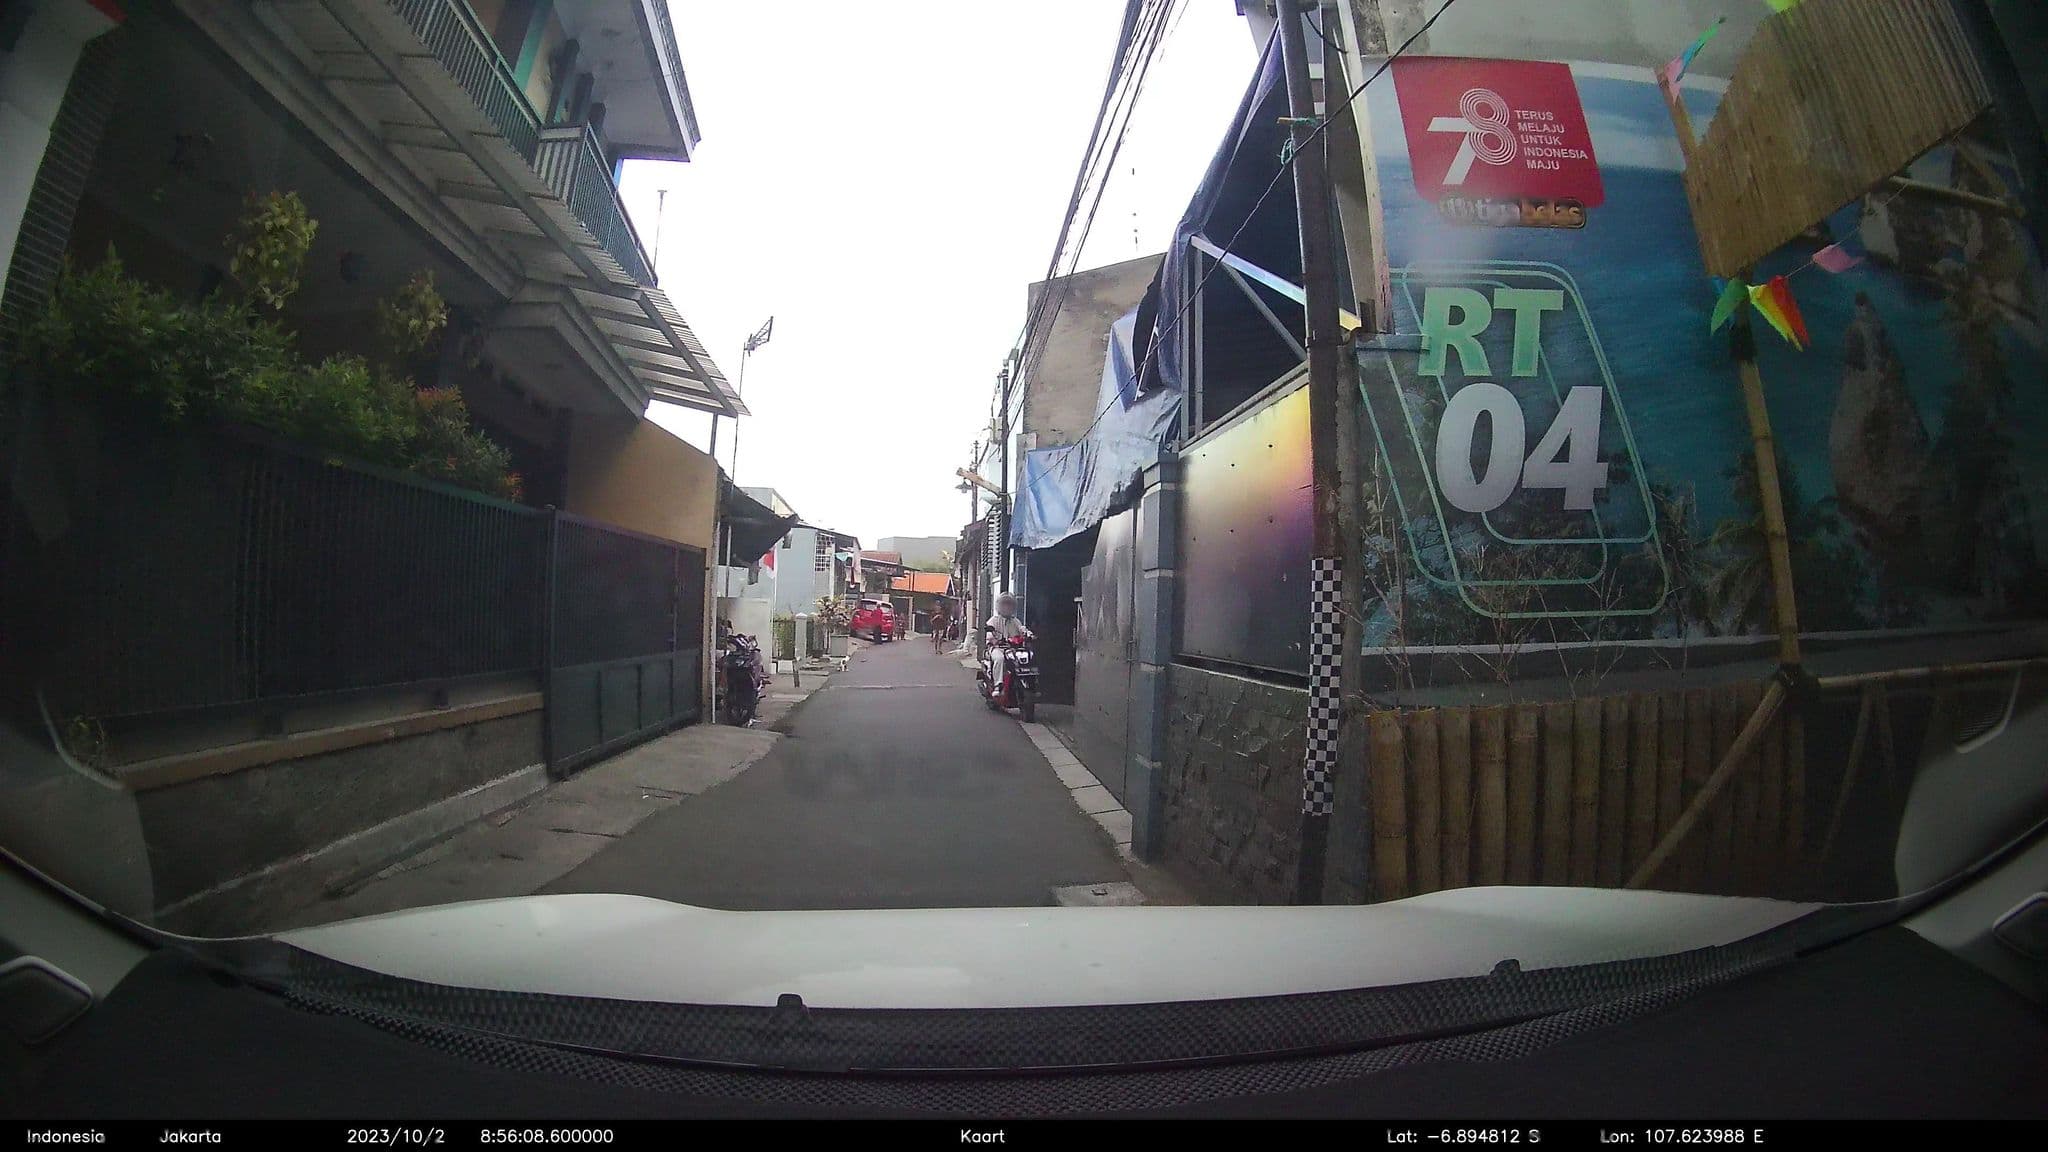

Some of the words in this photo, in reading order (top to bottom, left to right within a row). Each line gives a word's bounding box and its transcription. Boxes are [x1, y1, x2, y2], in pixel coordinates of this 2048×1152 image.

[1514, 109, 1554, 121] TERUS
[1518, 122, 1565, 134] MELAJU
[1427, 88, 1517, 185] 78
[1521, 134, 1562, 146] UNTUK
[1523, 147, 1589, 160] INDONESIA
[1526, 160, 1560, 170] MAJU
[1418, 287, 1564, 377] RT
[1435, 382, 1609, 513] 04
